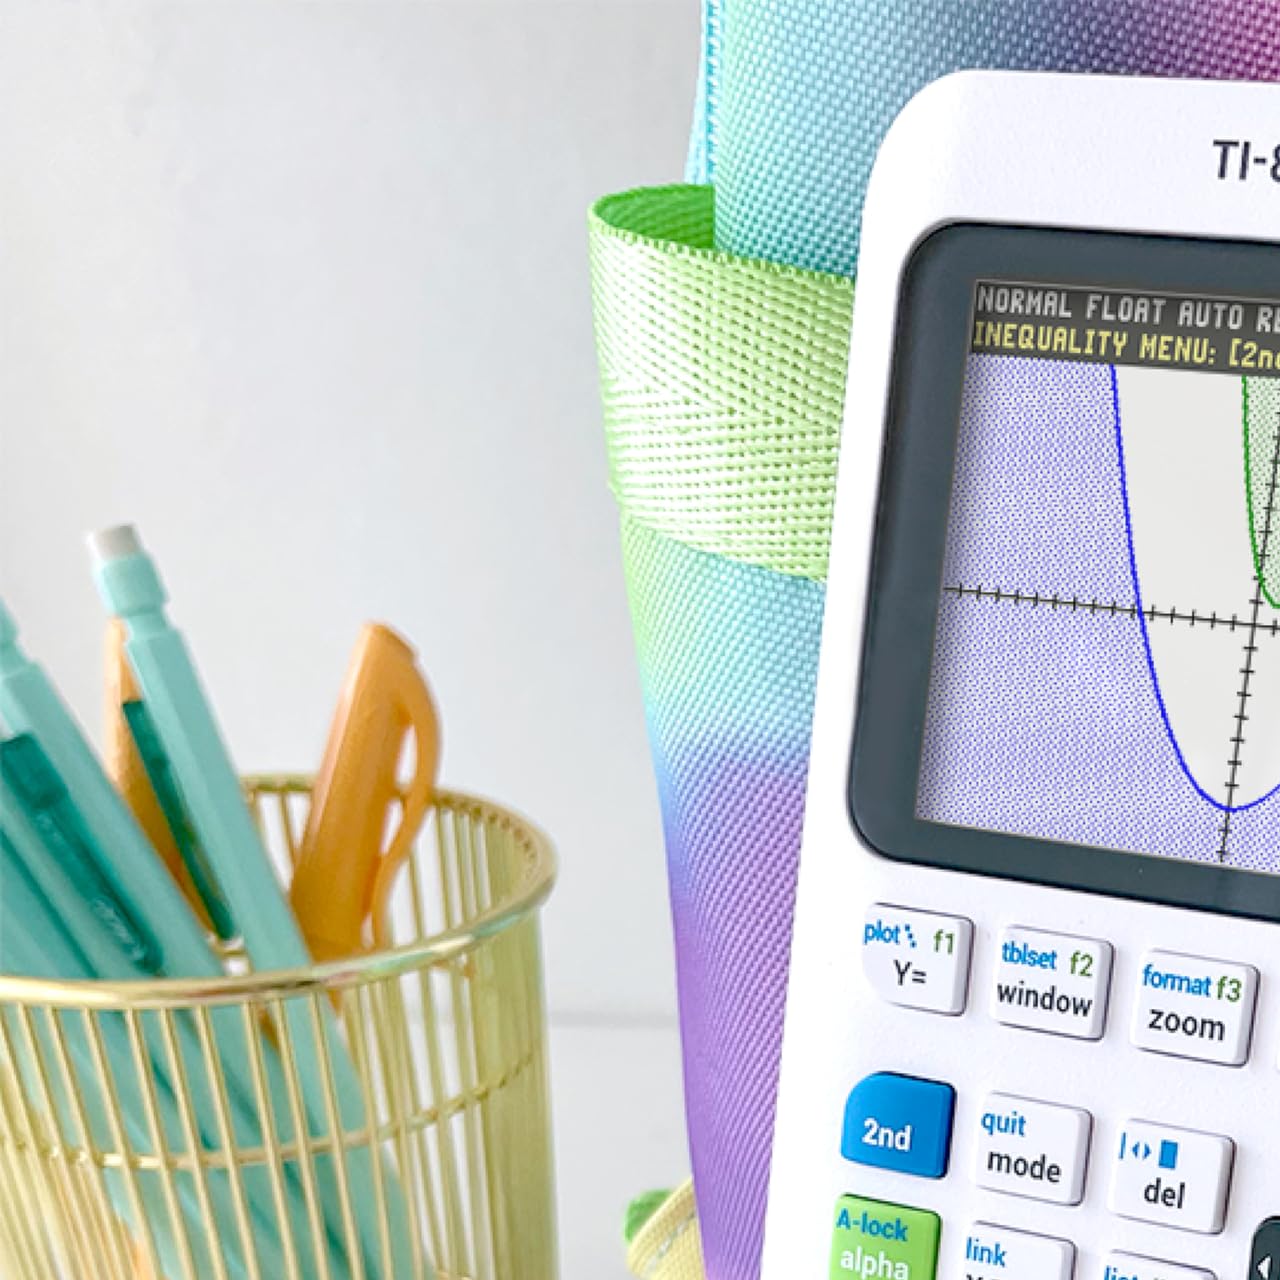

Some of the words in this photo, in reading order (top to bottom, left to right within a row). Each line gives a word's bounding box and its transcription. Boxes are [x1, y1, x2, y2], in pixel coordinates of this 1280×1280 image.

[978, 286, 1073, 319] NORMAL
[1086, 295, 1164, 324] FLOAT
[1178, 302, 1243, 330] AUTO
[973, 322, 1129, 357] INEQUALITY
[1139, 333, 1216, 365] MENU:
[863, 918, 902, 945] plot
[932, 928, 956, 954] f1
[894, 959, 927, 986] Y=
[1001, 942, 1058, 971] tblset
[1069, 952, 1094, 978] f2
[1142, 963, 1213, 997] format
[1217, 976, 1242, 1002] f3
[997, 980, 1093, 1017] window
[1148, 1008, 1225, 1041] zoom
[862, 1118, 911, 1151] 2nd
[980, 1109, 1026, 1137] quit
[987, 1151, 1061, 1183] mode
[1144, 1177, 1186, 1209] del
[835, 1210, 908, 1243] A-lock
[965, 1237, 1006, 1266] link
